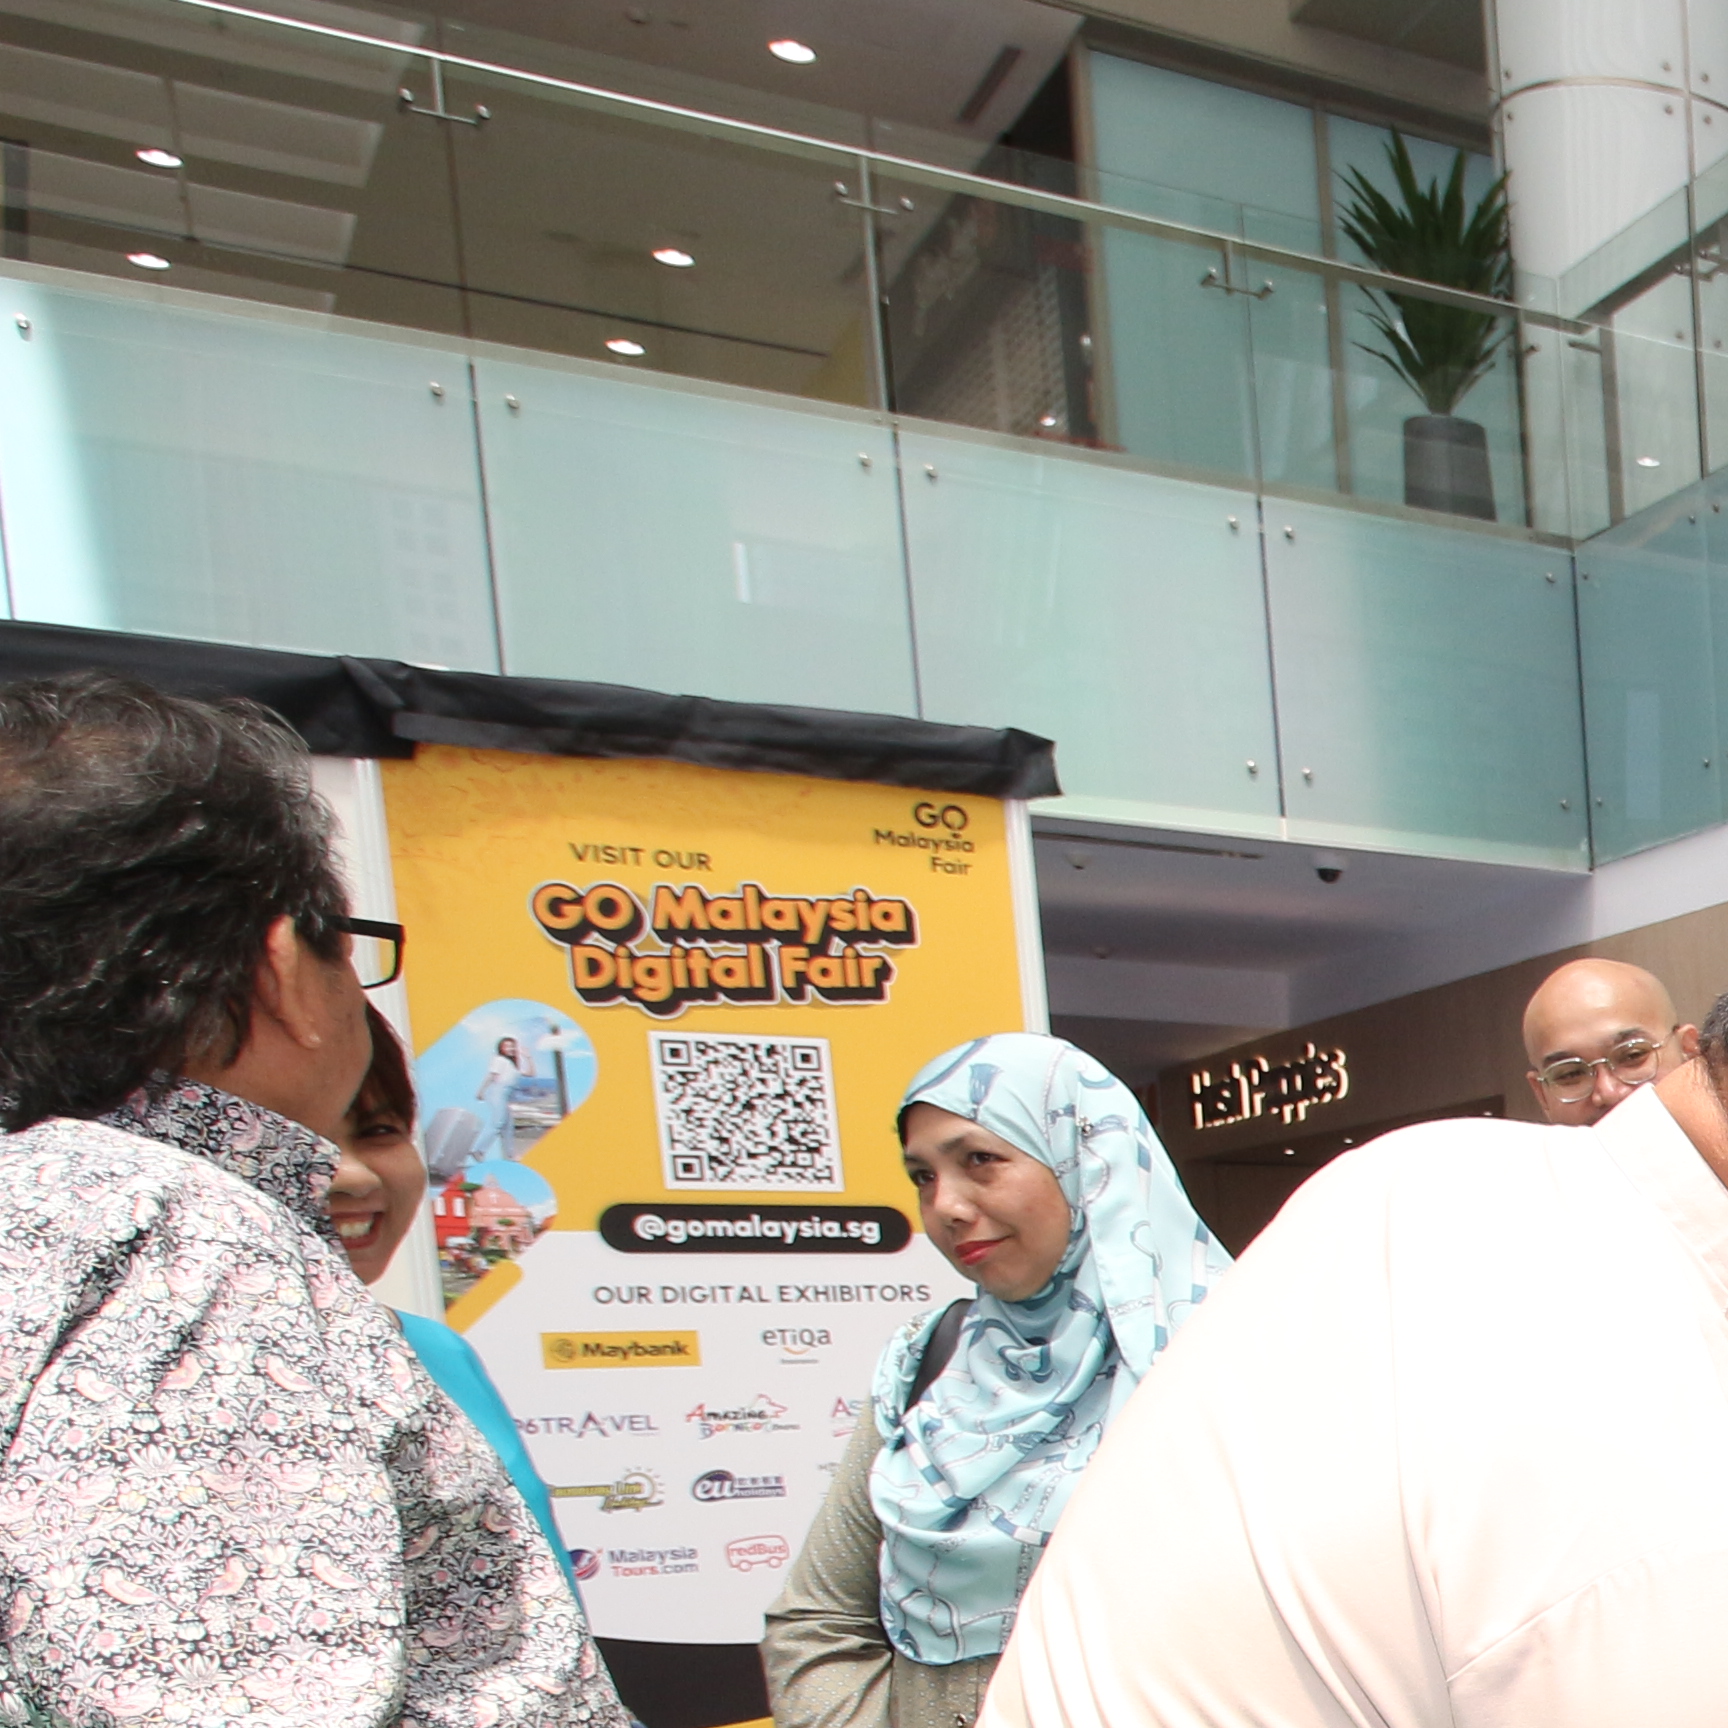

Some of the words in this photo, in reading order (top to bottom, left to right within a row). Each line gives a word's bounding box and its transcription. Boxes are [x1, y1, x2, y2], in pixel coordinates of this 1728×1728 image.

[914, 802, 968, 834] GO
[874, 827, 976, 855] Malaysia
[570, 842, 646, 867] VISIT
[655, 848, 713, 872] OUR
[930, 856, 973, 876] Fair
[531, 884, 640, 940] GO
[652, 884, 912, 946] Malaysia
[571, 945, 772, 1008] Digital
[779, 946, 890, 998] Fair
[632, 1214, 883, 1245] @gomalaysia.sg
[593, 1285, 653, 1305] OUR
[661, 1284, 771, 1305] DIGITAL
[779, 1284, 932, 1303] EXHIBITORS
[581, 1340, 691, 1361] Maybank
[608, 1547, 698, 1565] Malaysia
[729, 1543, 787, 1557] redBus
[610, 1563, 699, 1578] Tours.com
